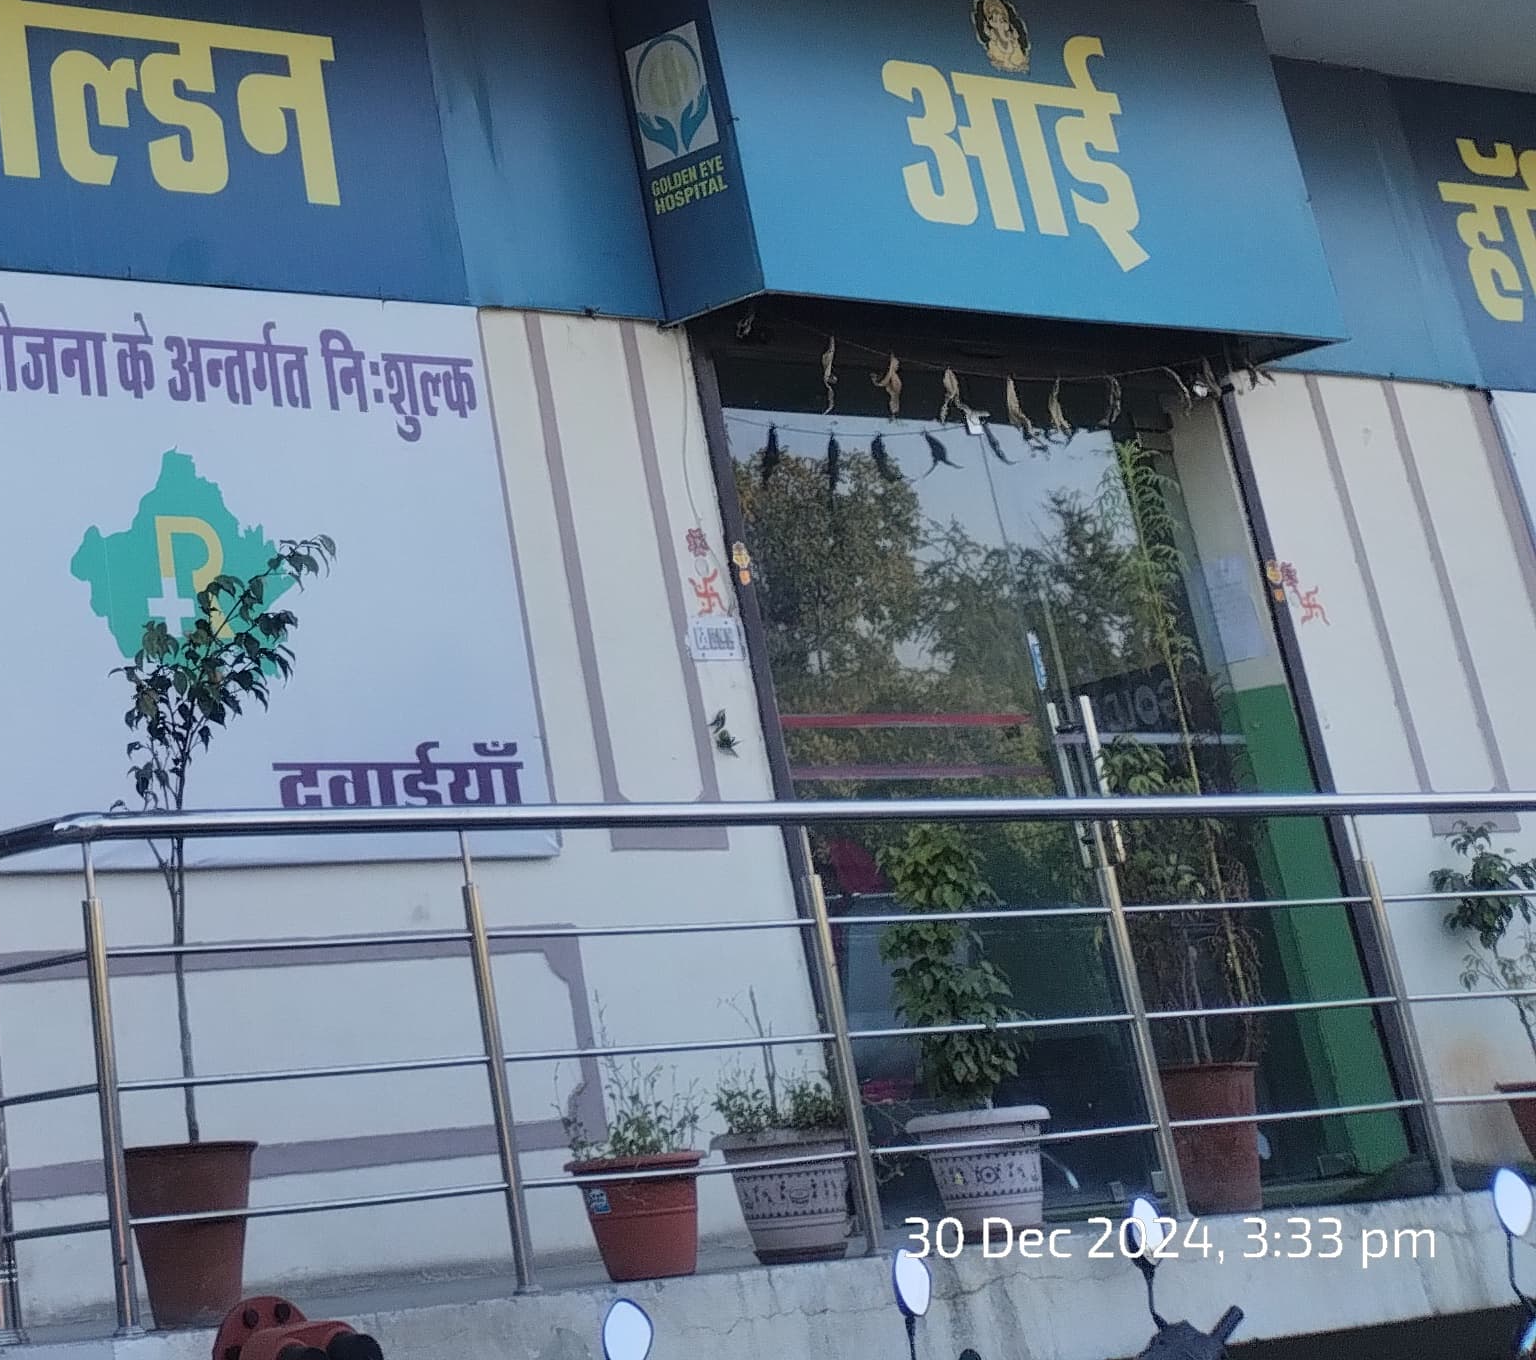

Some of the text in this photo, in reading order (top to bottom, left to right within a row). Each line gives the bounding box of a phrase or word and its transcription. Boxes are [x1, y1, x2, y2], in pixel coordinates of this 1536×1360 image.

[651, 154, 725, 198] GOLDEN EYE
[880, 34, 1152, 274] आई
[654, 174, 729, 216] HOSPITAL
[112, 312, 157, 400] के
